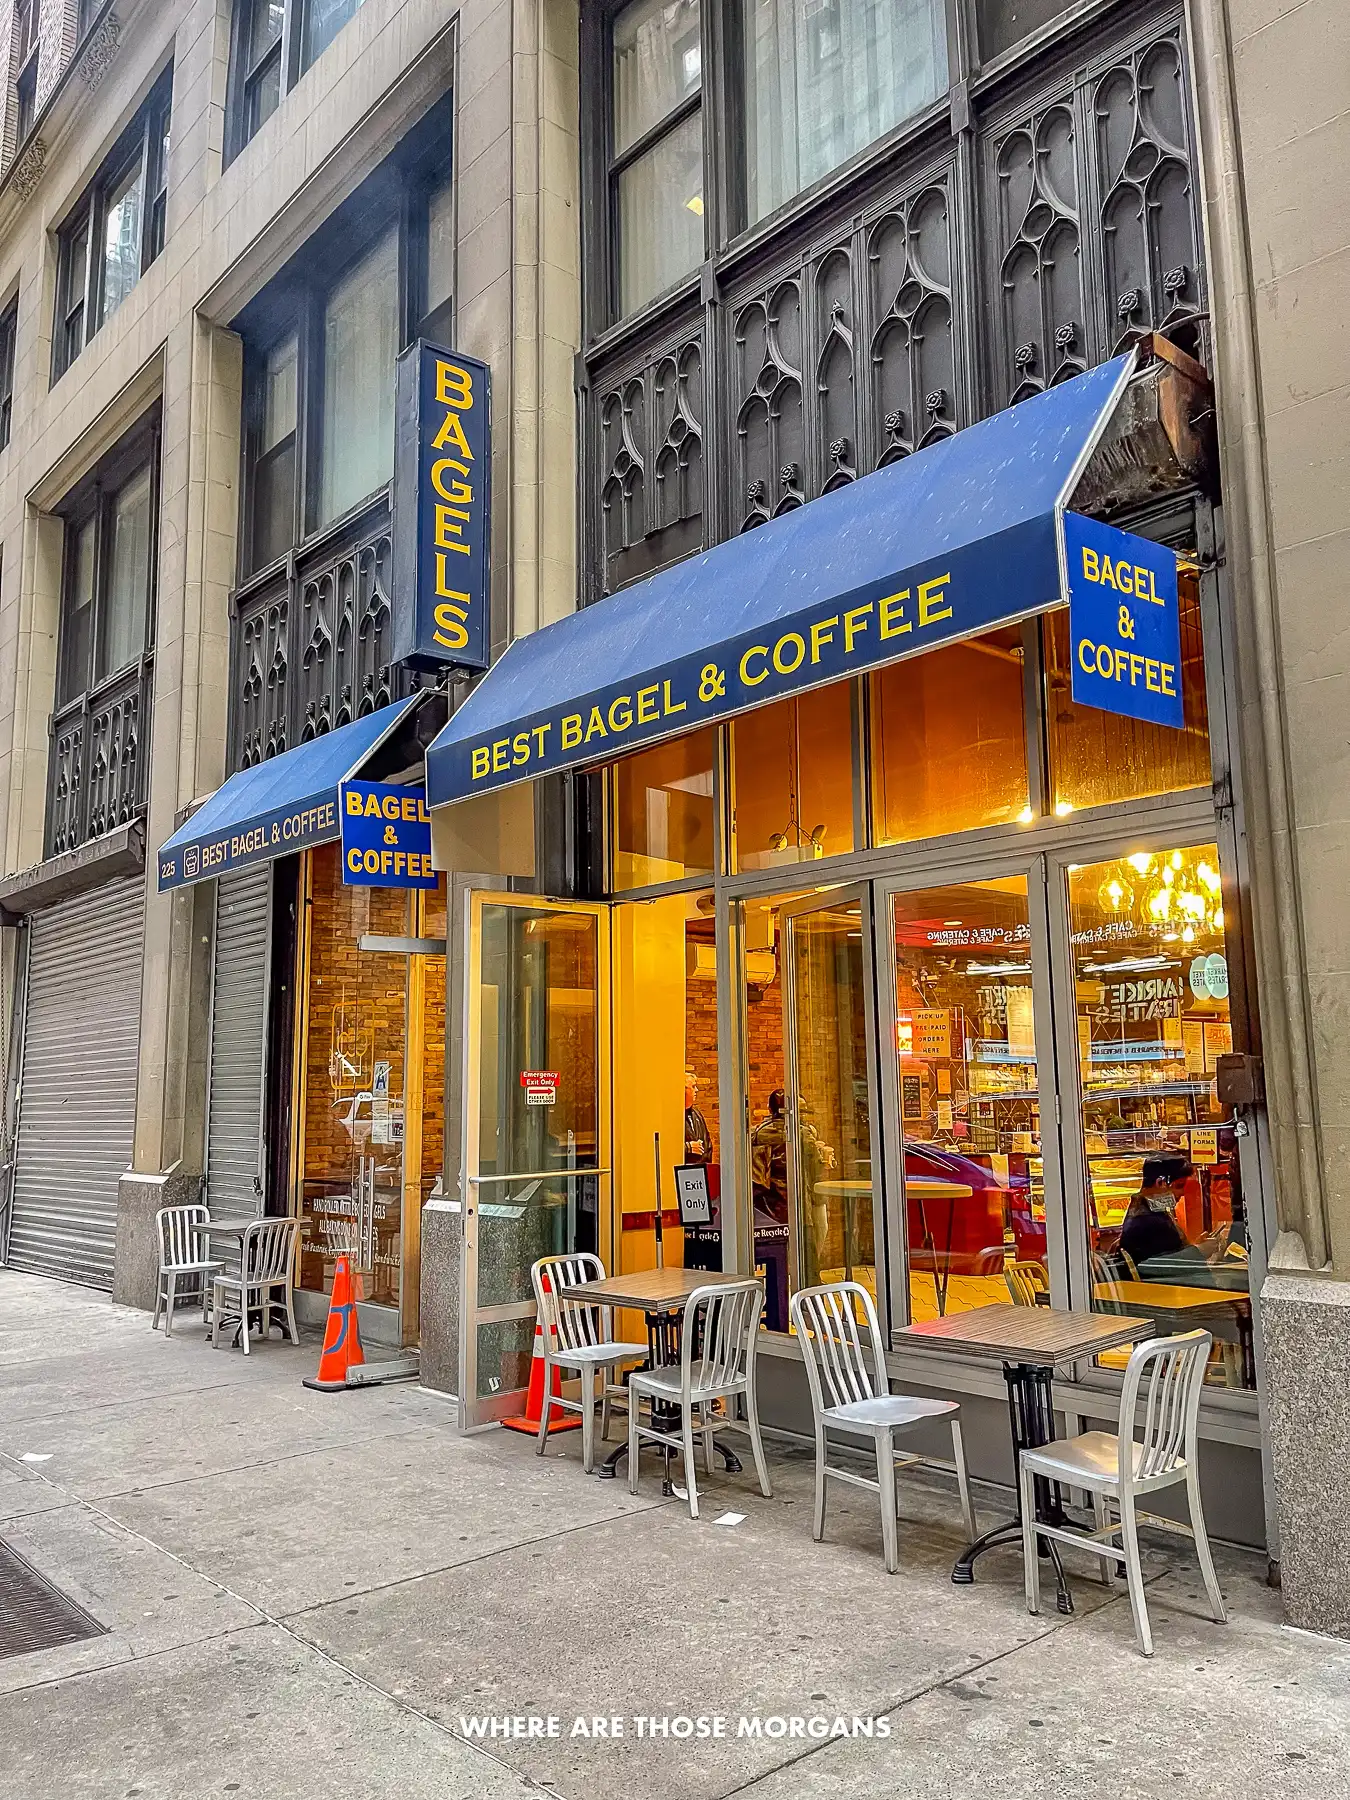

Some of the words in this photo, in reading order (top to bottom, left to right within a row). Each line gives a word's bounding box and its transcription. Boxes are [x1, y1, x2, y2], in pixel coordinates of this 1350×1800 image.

[430, 359, 475, 649] BAGELS
[1082, 546, 1165, 607] BAGEL
[1118, 605, 1135, 640] &
[471, 721, 552, 780] BEST
[561, 679, 686, 751] BAGEL
[698, 663, 726, 703] &
[738, 572, 953, 687] COFFEE
[1078, 638, 1177, 697] COFFEE
[346, 792, 431, 823] BAGEL
[161, 860, 175, 878] 225
[202, 840, 230, 868] BEST
[231, 826, 269, 858] BAGEL
[271, 822, 280, 843] &
[283, 801, 335, 840] COFFEE
[383, 825, 398, 845] &
[347, 848, 435, 877] COFFEE
[685, 1180, 703, 1190] Exit
[686, 1199, 706, 1210] Only
[761, 1228, 783, 1238] Recycle
